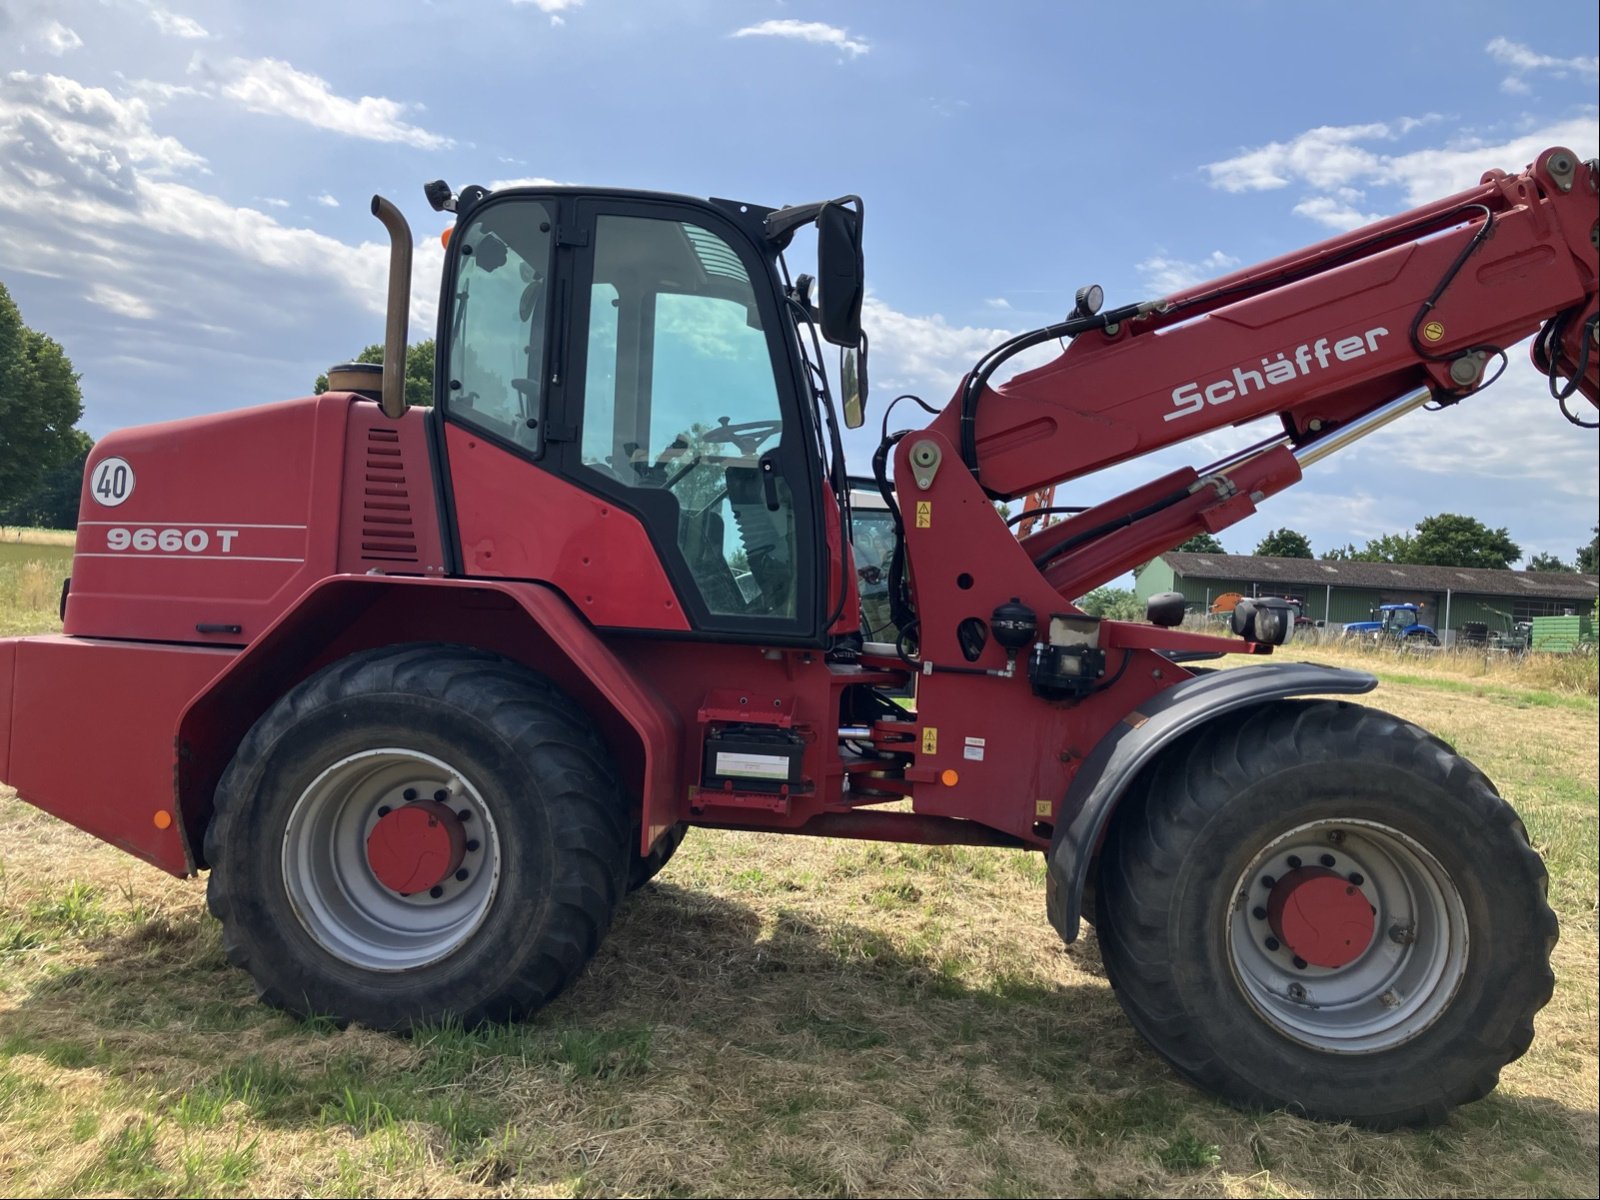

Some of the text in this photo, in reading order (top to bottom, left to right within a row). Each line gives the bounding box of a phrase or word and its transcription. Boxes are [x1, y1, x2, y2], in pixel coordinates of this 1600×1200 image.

[1163, 327, 1389, 422] Schäffer
[96, 465, 127, 498] 40
[106, 528, 239, 553] 9660 T
